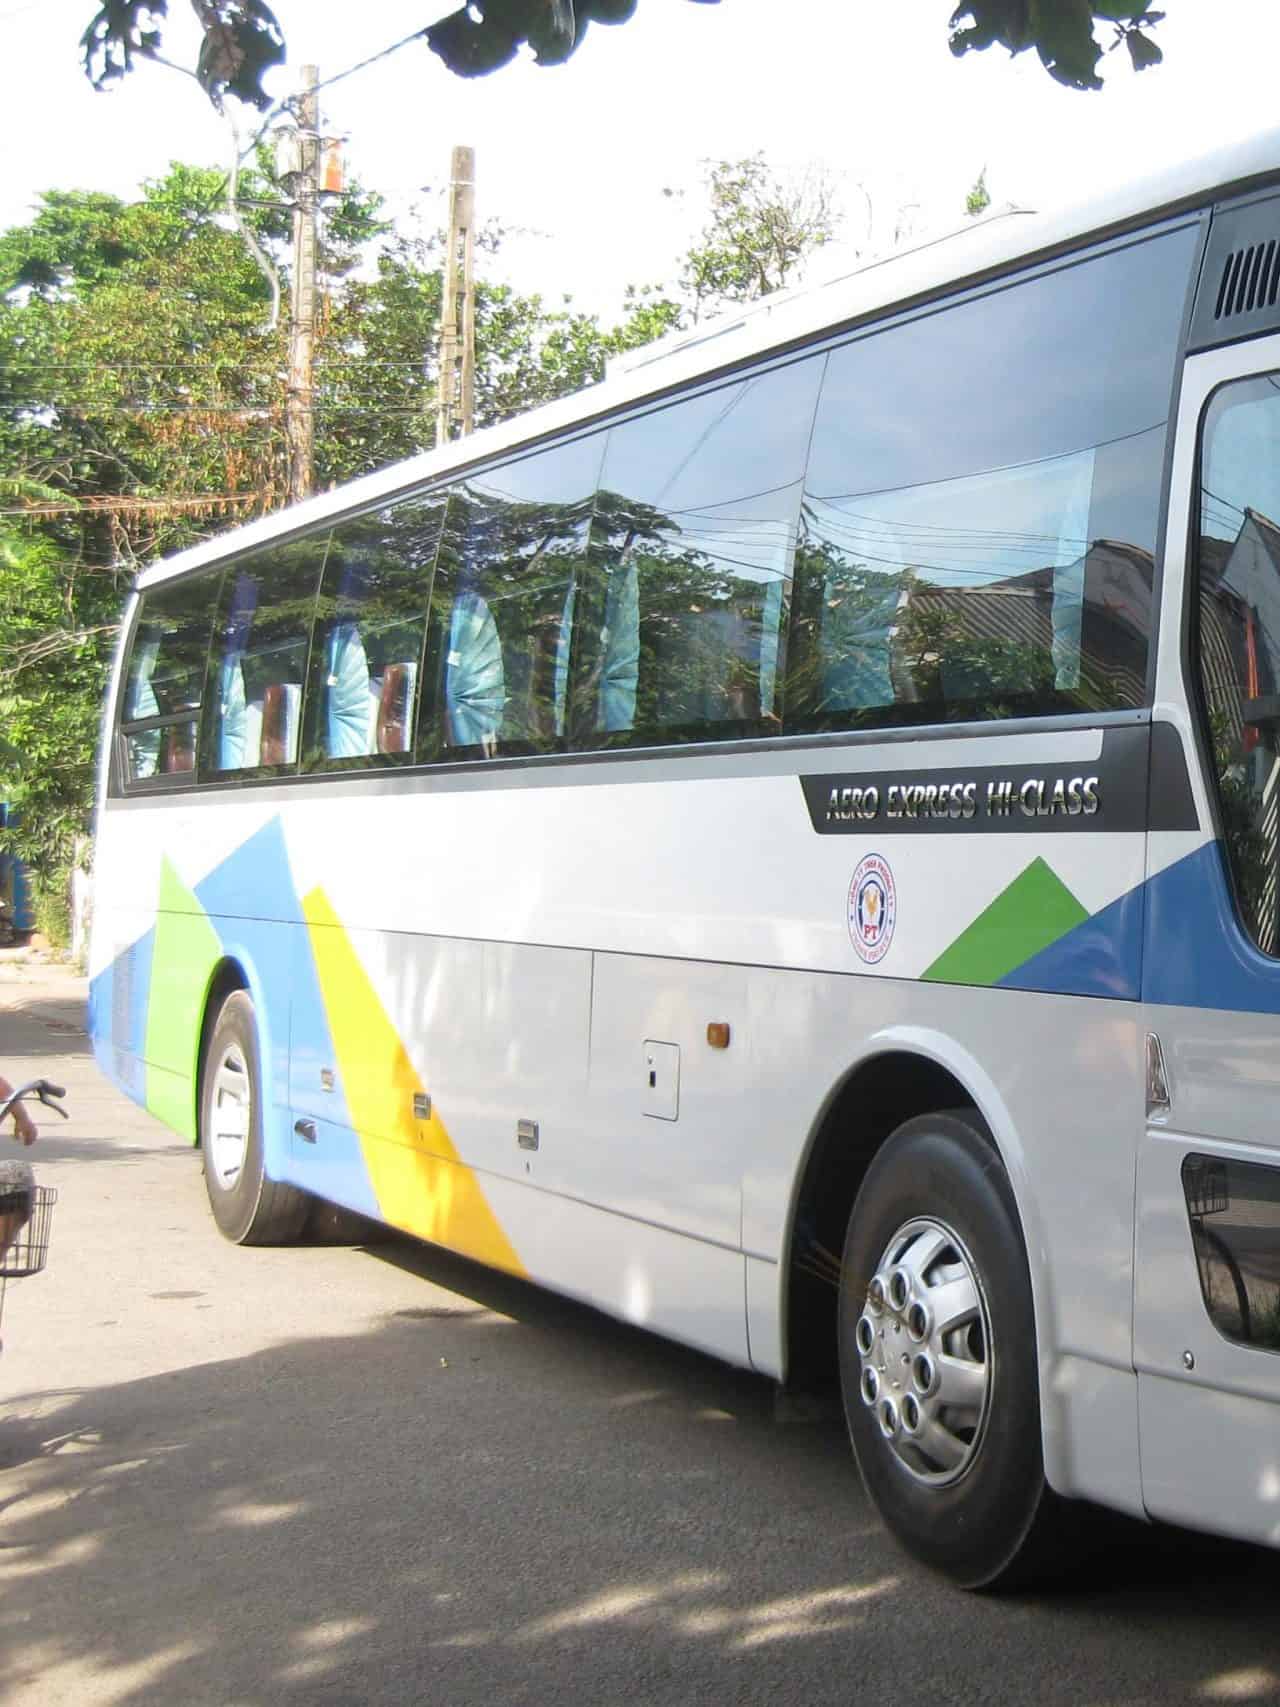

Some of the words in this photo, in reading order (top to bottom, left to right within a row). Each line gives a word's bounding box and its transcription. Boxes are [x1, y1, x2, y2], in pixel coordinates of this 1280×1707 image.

[826, 786, 879, 820] AERO
[886, 782, 977, 818] EXPRESS
[986, 777, 1098, 817] HI-CLASS
[863, 924, 879, 940] PT
